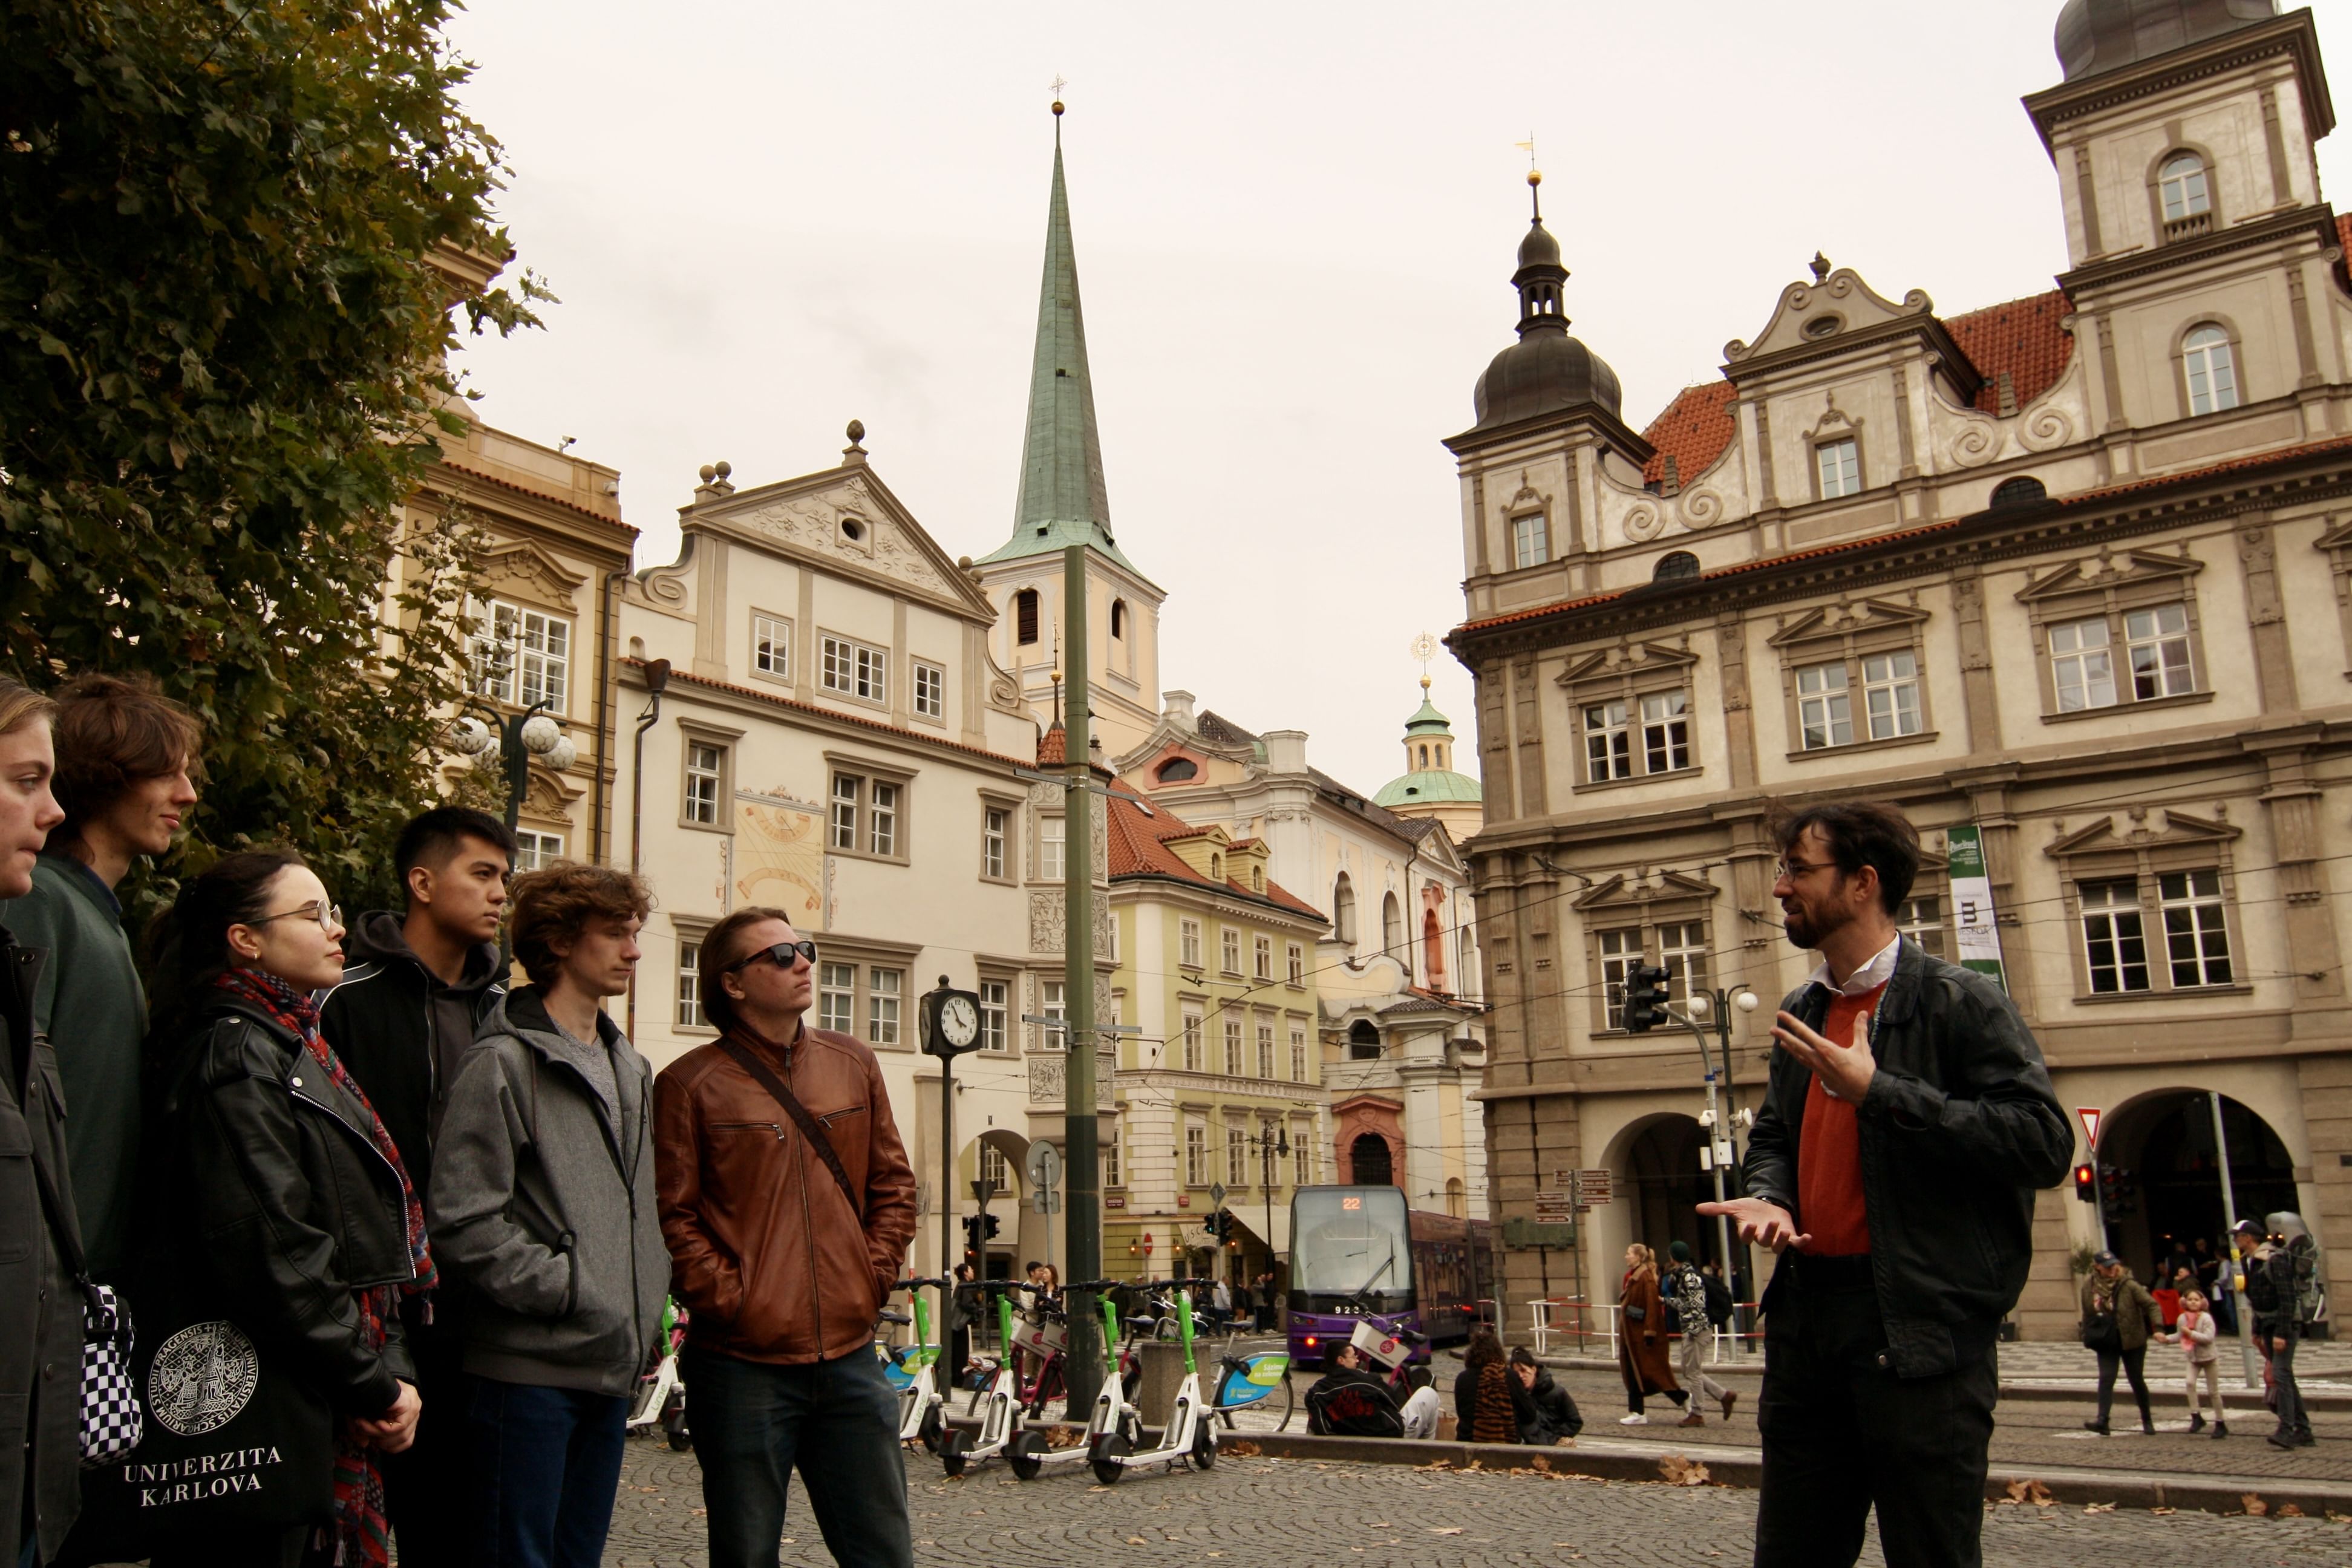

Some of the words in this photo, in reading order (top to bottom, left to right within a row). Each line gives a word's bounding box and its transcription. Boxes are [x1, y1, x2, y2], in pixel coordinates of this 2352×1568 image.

[1342, 1197, 1361, 1210] 22
[155, 1325, 203, 1367] PRAGENSIS
[151, 1370, 161, 1406] STUDII
[217, 1349, 256, 1423] UNIVERSITATIS
[124, 1446, 283, 1482] UNIVERZITA
[141, 1473, 263, 1506] KARLOVA
